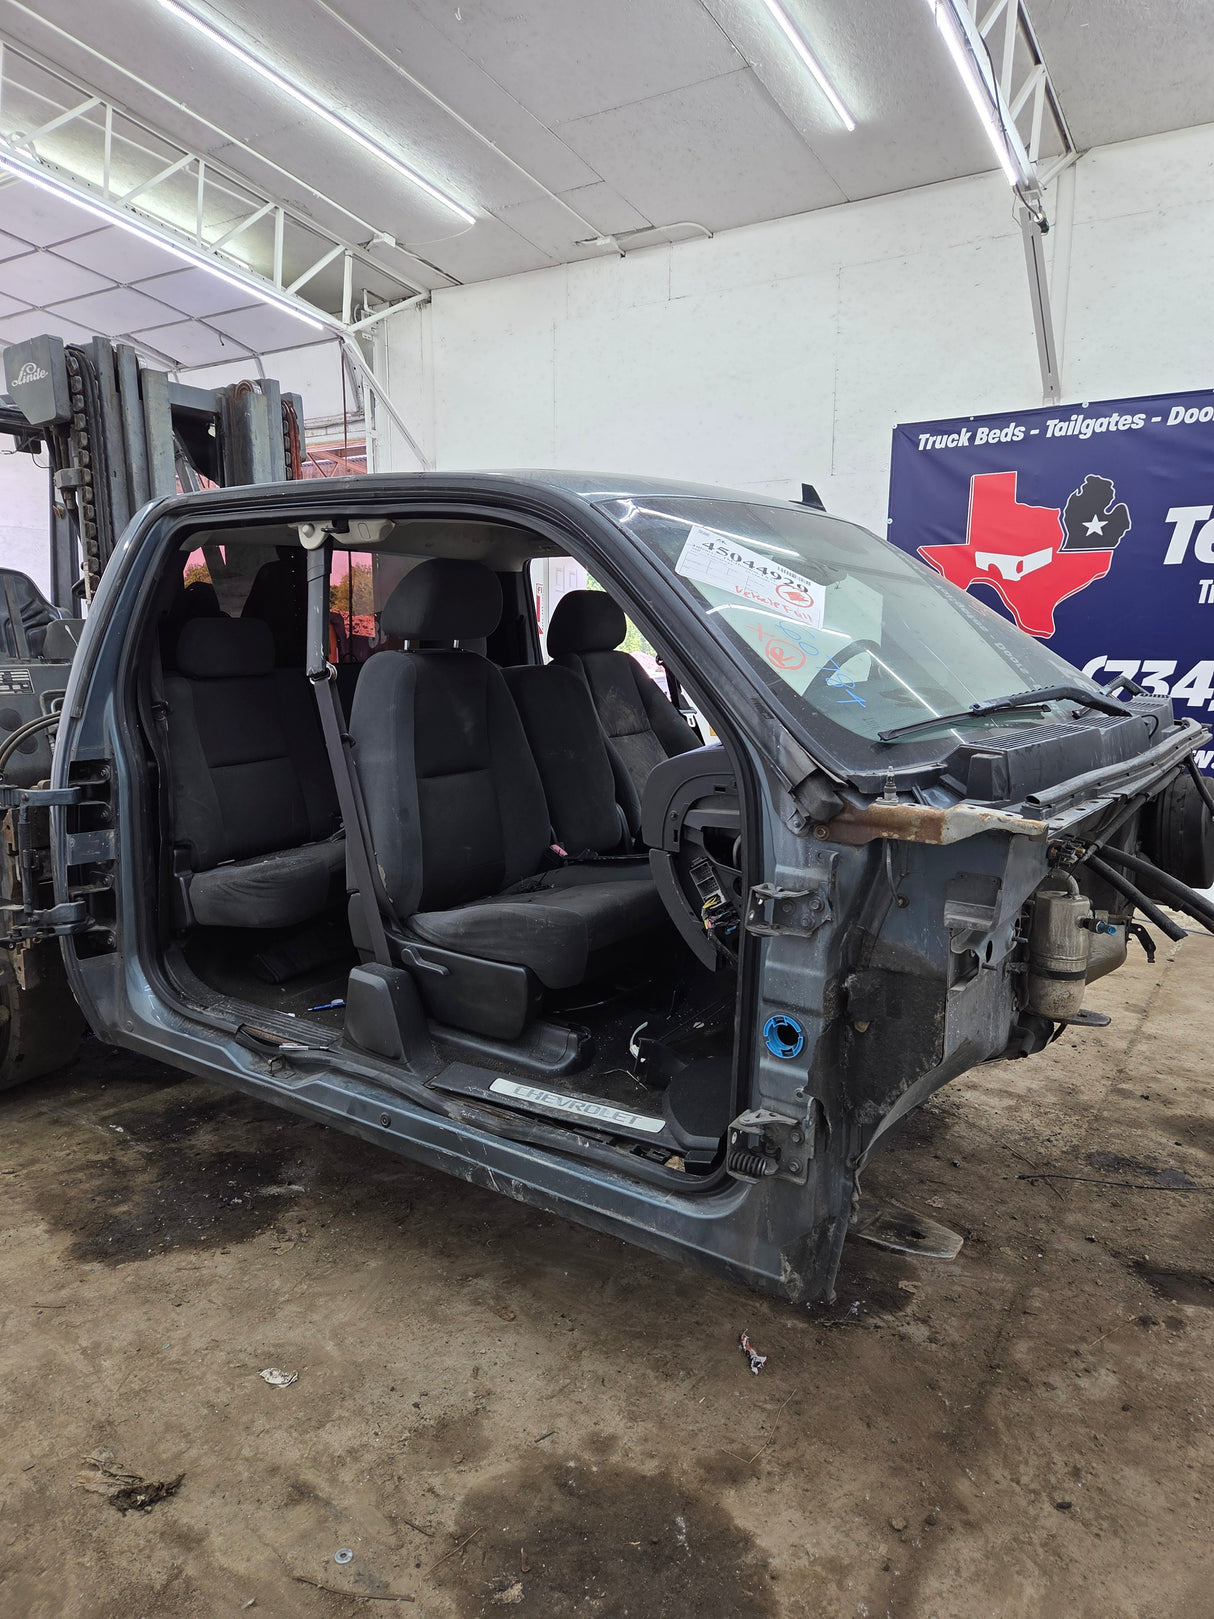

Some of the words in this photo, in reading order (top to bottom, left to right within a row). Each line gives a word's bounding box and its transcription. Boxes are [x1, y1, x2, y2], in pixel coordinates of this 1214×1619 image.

[11, 362, 49, 387] Linde
[918, 428, 972, 450] Truck
[974, 422, 1026, 445] Beds
[1046, 412, 1146, 439] Tailgates
[1167, 406, 1214, 426] Doo
[1080, 655, 1214, 711] (734
[513, 1086, 643, 1125] CHEVROLET
